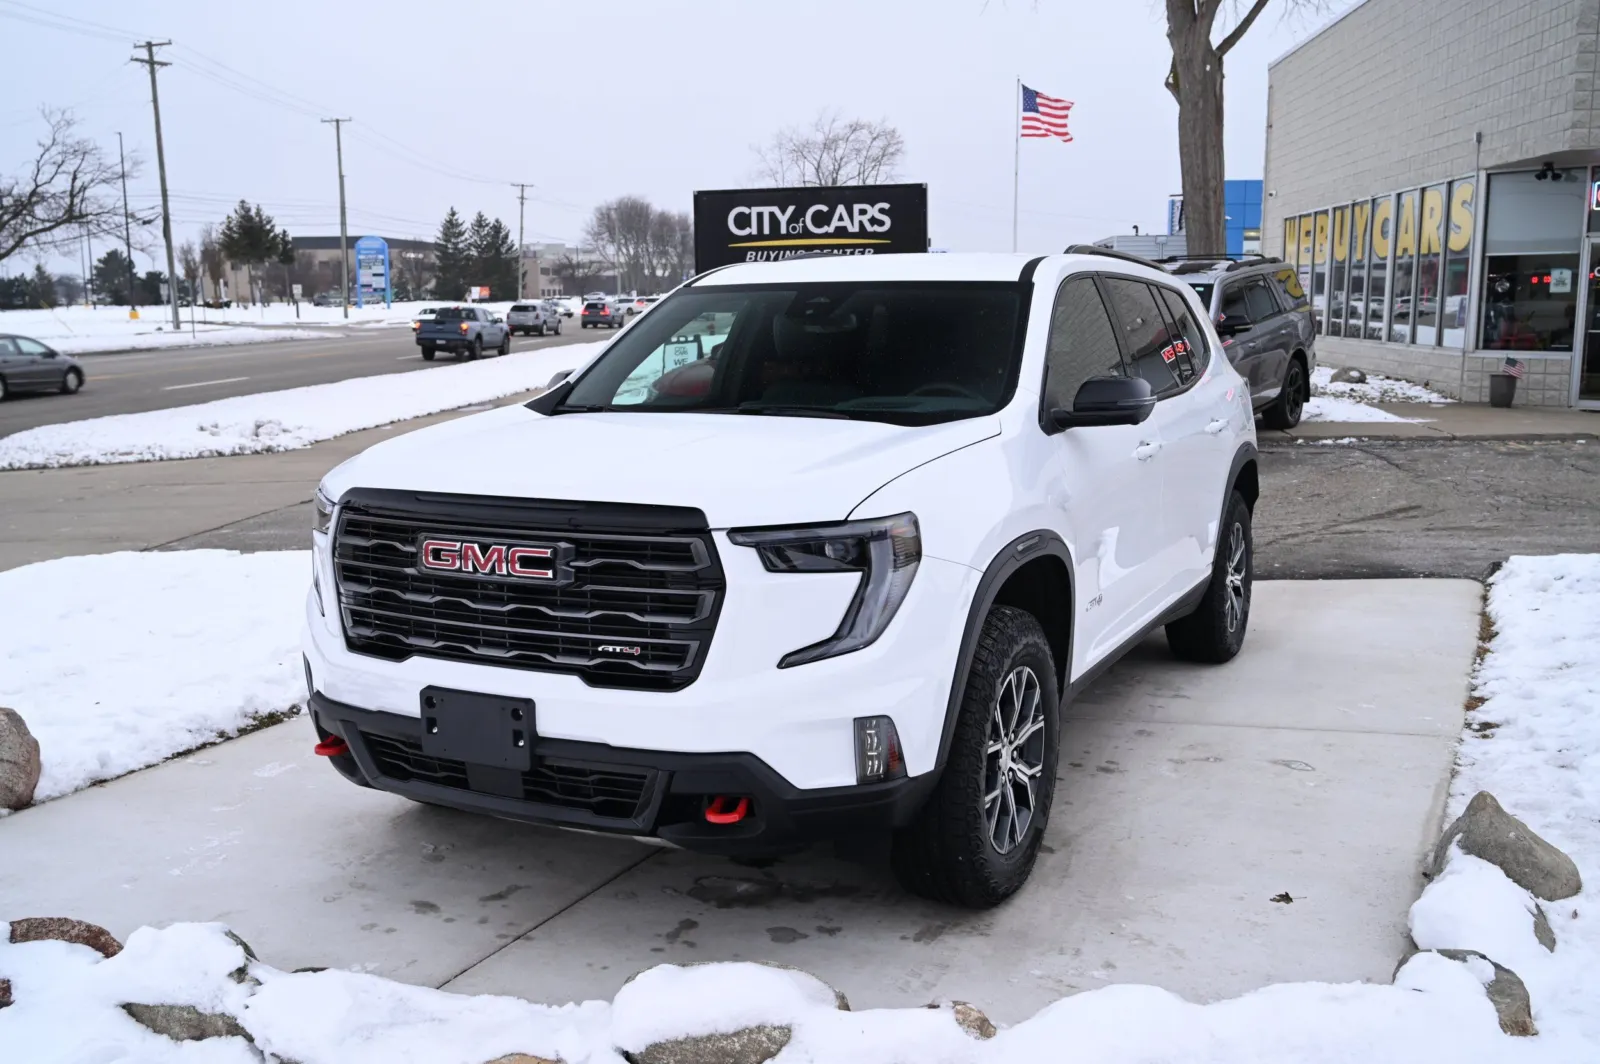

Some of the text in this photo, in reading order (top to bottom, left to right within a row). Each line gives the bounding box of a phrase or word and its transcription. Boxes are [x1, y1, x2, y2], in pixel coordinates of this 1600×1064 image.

[727, 202, 892, 236] CITY of CARS
[1285, 183, 1475, 265] WE BUY CARS
[812, 248, 874, 256] NTER
[422, 540, 553, 578] GMC
[598, 645, 641, 656] AT4
